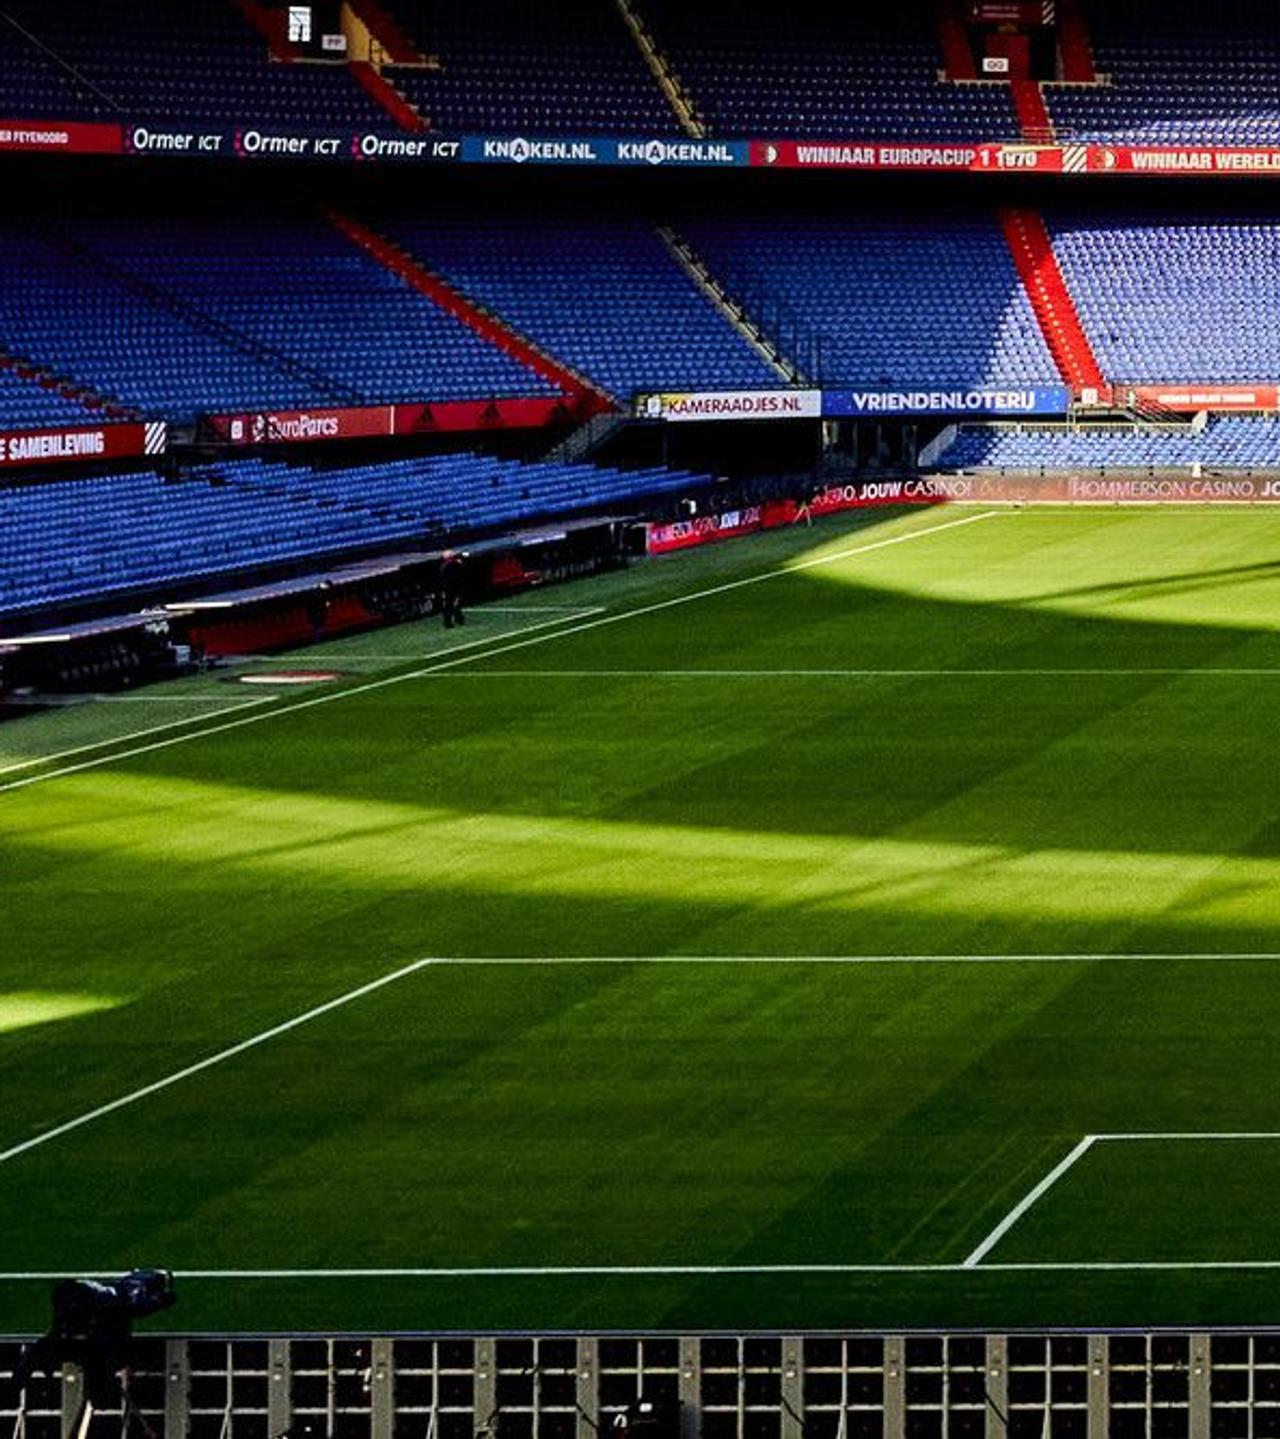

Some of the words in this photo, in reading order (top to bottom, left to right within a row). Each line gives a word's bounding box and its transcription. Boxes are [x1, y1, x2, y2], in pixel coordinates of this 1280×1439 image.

[132, 128, 193, 150] Ormer
[199, 134, 222, 150] ICT
[243, 131, 308, 152] Ormer
[314, 138, 340, 154] ICT
[361, 133, 426, 156] Ormer
[432, 140, 459, 157] ICT
[484, 138, 596, 163] KNAKEN.NL
[618, 140, 733, 165] KNAKEN.NL
[797, 146, 875, 163] WINNAAR
[880, 148, 974, 165] EUROPACUP
[1131, 152, 1211, 169] WINNAAR
[668, 397, 802, 414] KAMERAADJES.NL
[853, 391, 1035, 410] VRIENDENLOTERIJ
[9, 432, 104, 460] SAMENLEVING
[859, 482, 902, 500] JOUW
[904, 479, 972, 497] CASINO!
[1072, 482, 1186, 497] HOMMERSON
